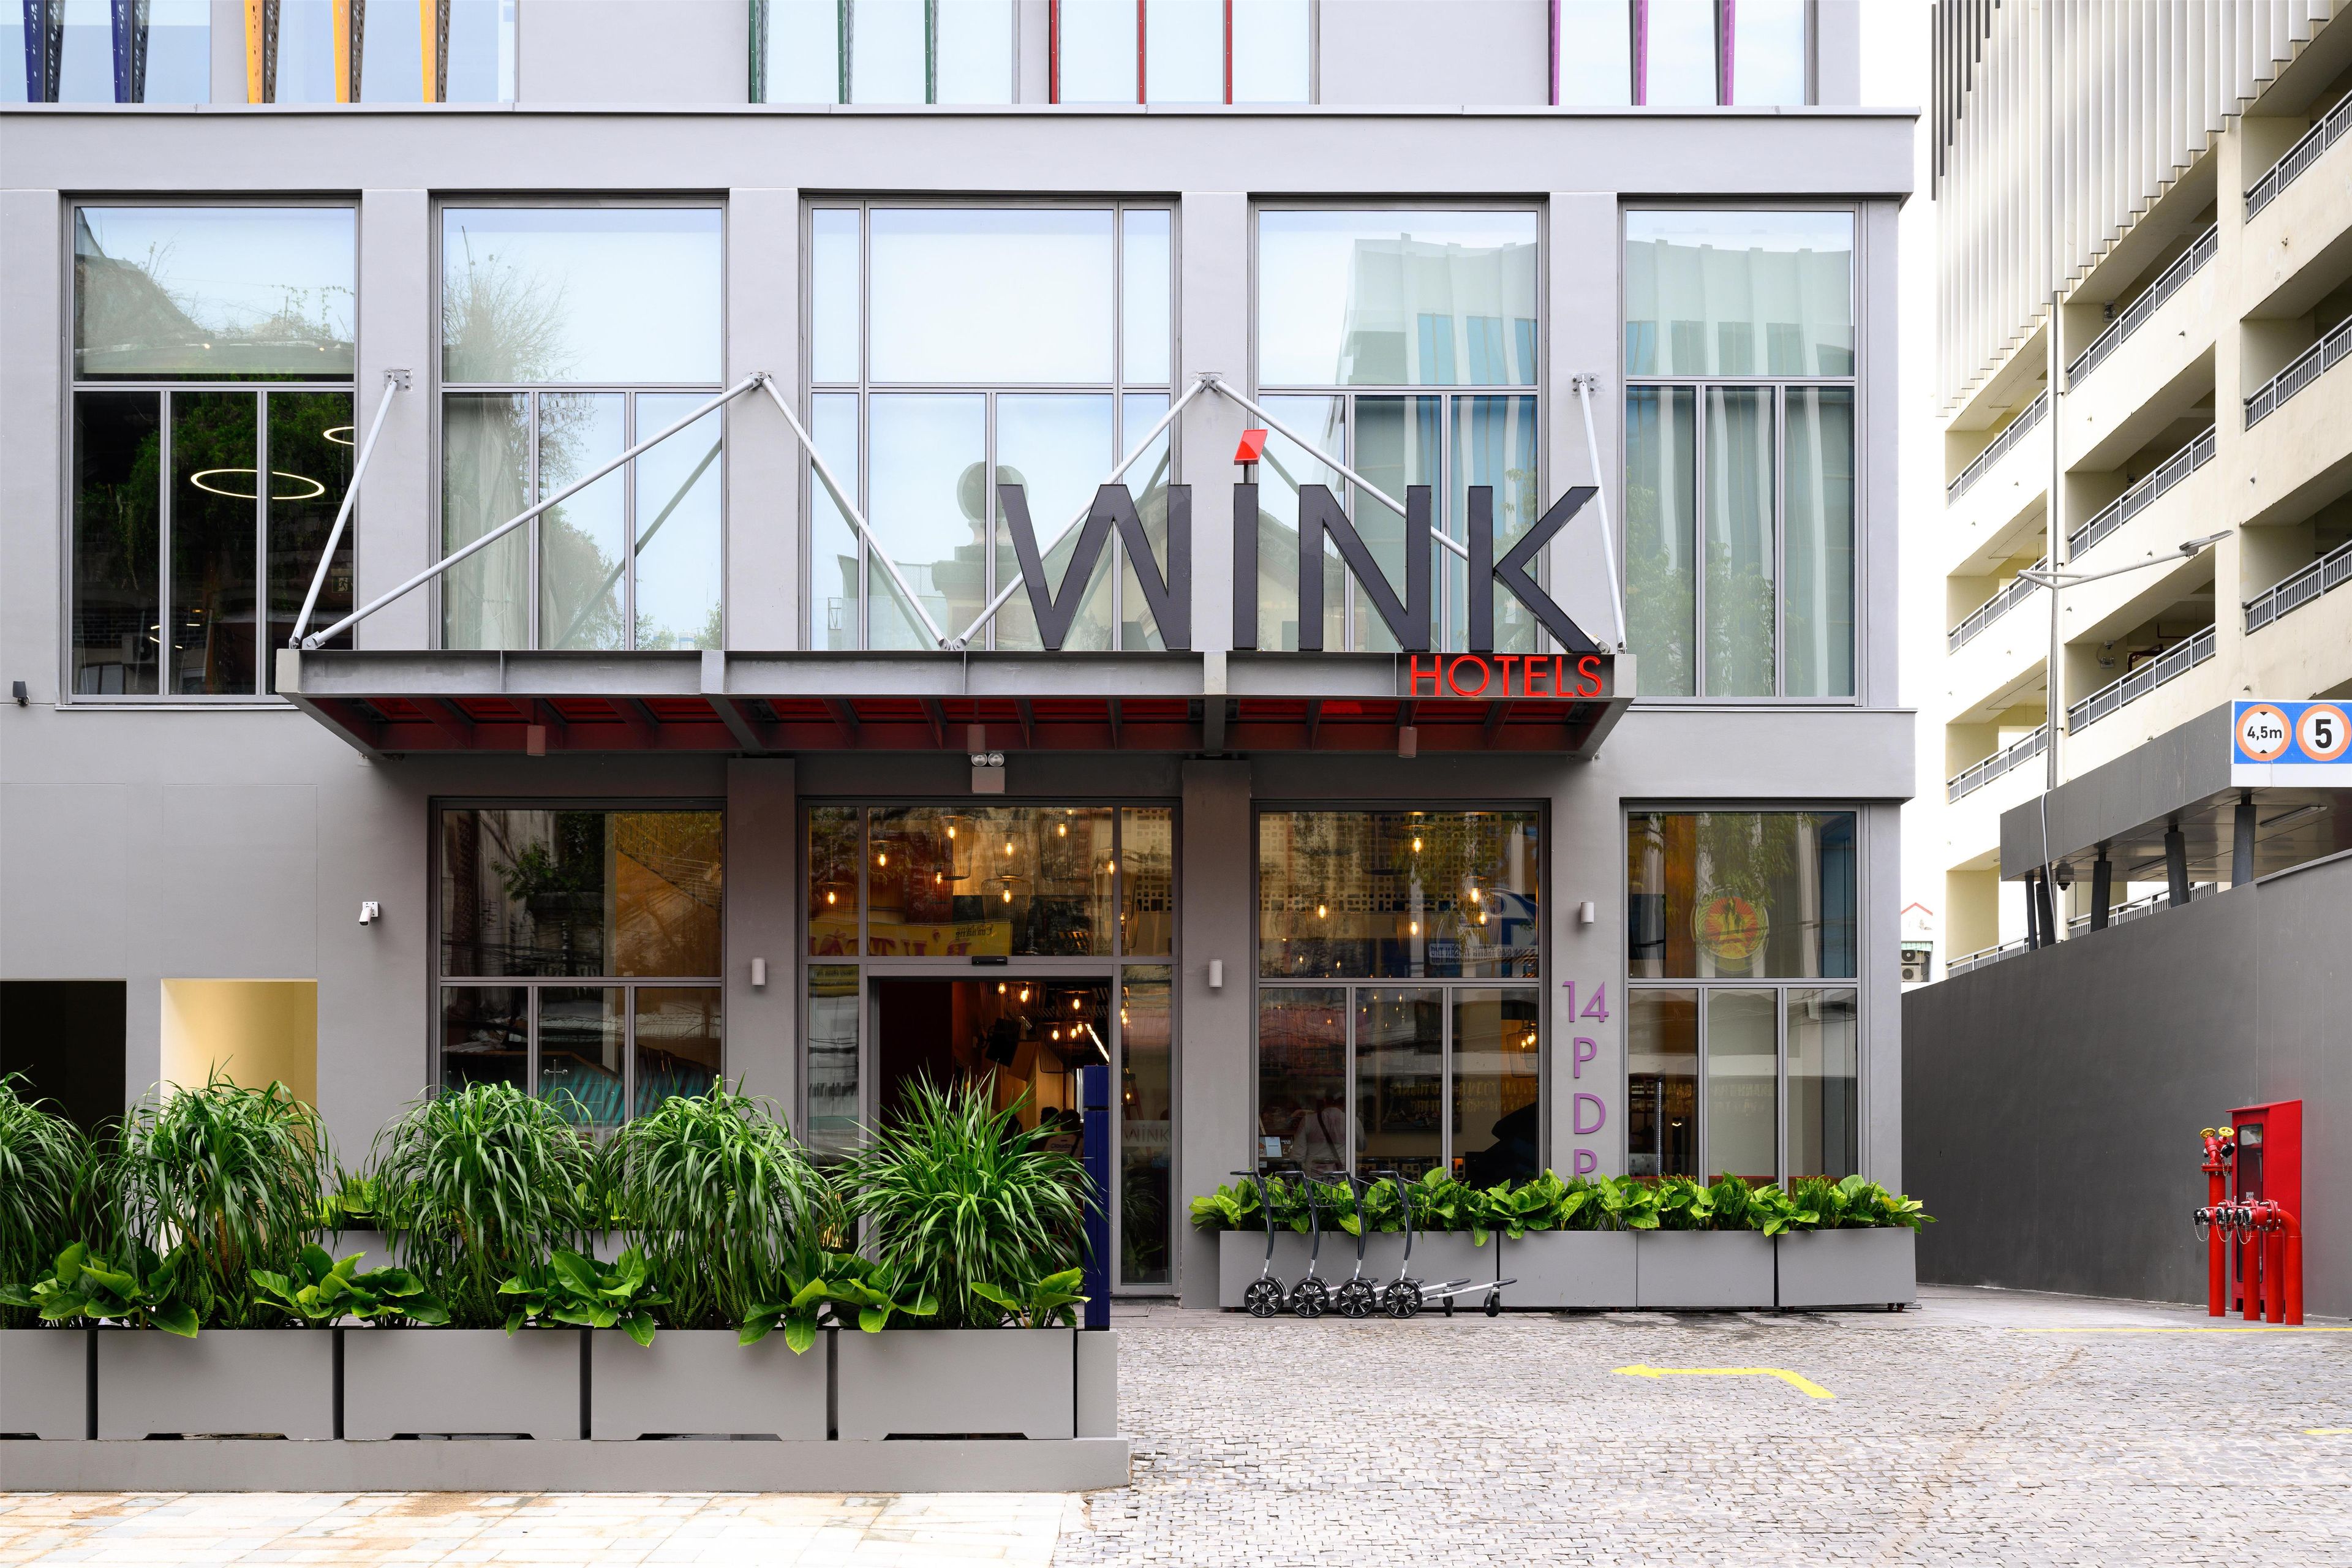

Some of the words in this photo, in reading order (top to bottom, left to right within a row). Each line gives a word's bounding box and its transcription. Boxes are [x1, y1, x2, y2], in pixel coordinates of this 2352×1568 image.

[1411, 655, 1603, 698] HOTELS
[2247, 726, 2282, 741] 4,5m
[2315, 718, 2332, 748] 5
[1562, 981, 1610, 1023] 14
